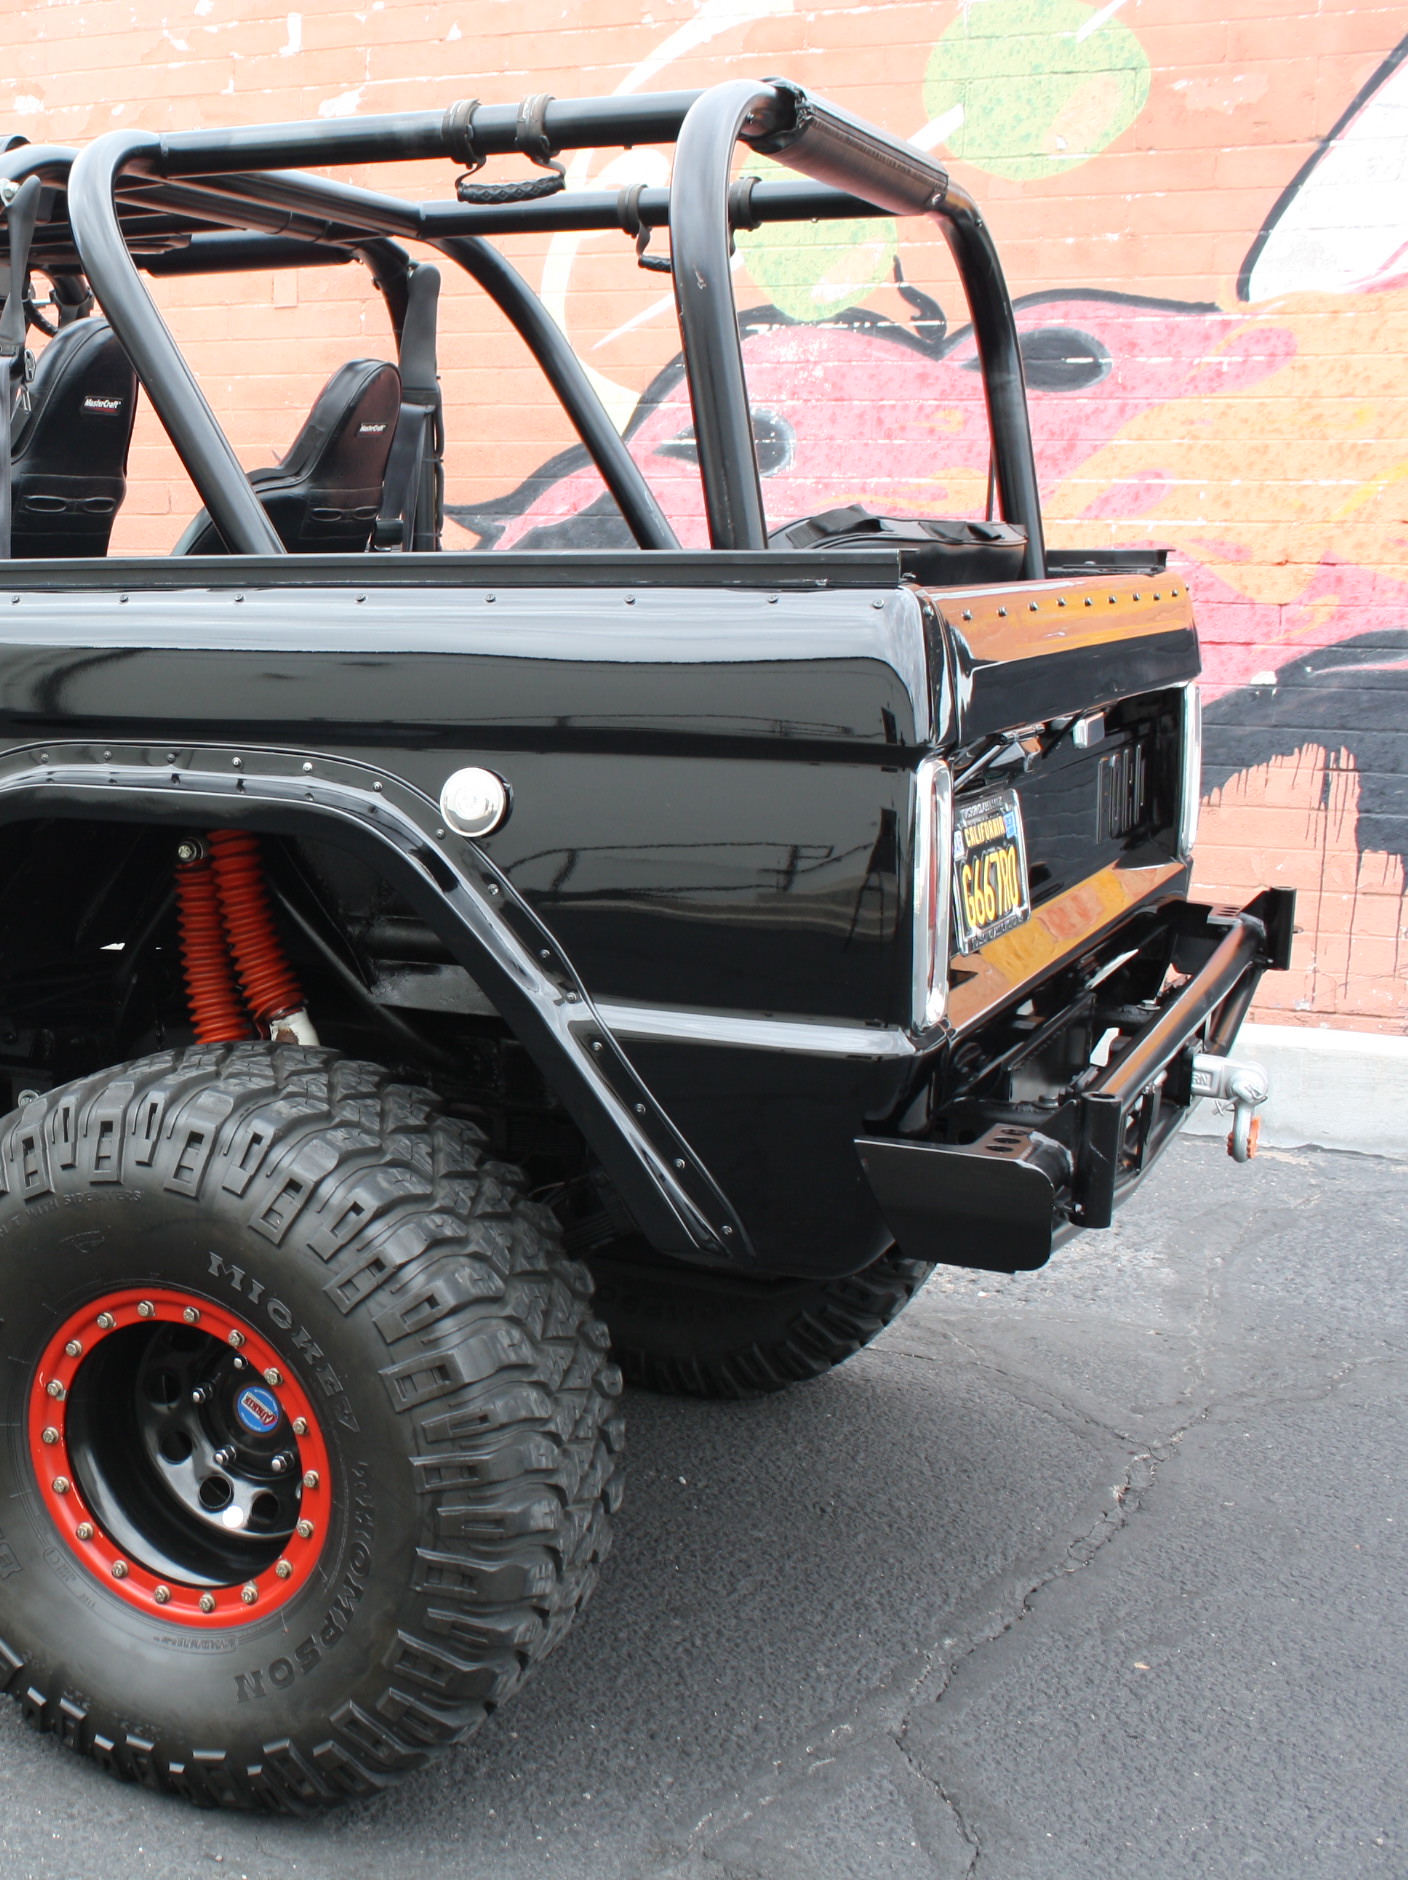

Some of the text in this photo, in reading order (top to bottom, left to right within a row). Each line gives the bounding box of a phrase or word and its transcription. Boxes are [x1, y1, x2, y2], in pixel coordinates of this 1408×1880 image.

[964, 815, 1006, 847] CALIFORNIA
[207, 1251, 361, 1433] MICKEY
[233, 1460, 375, 1704] THOMPSON
